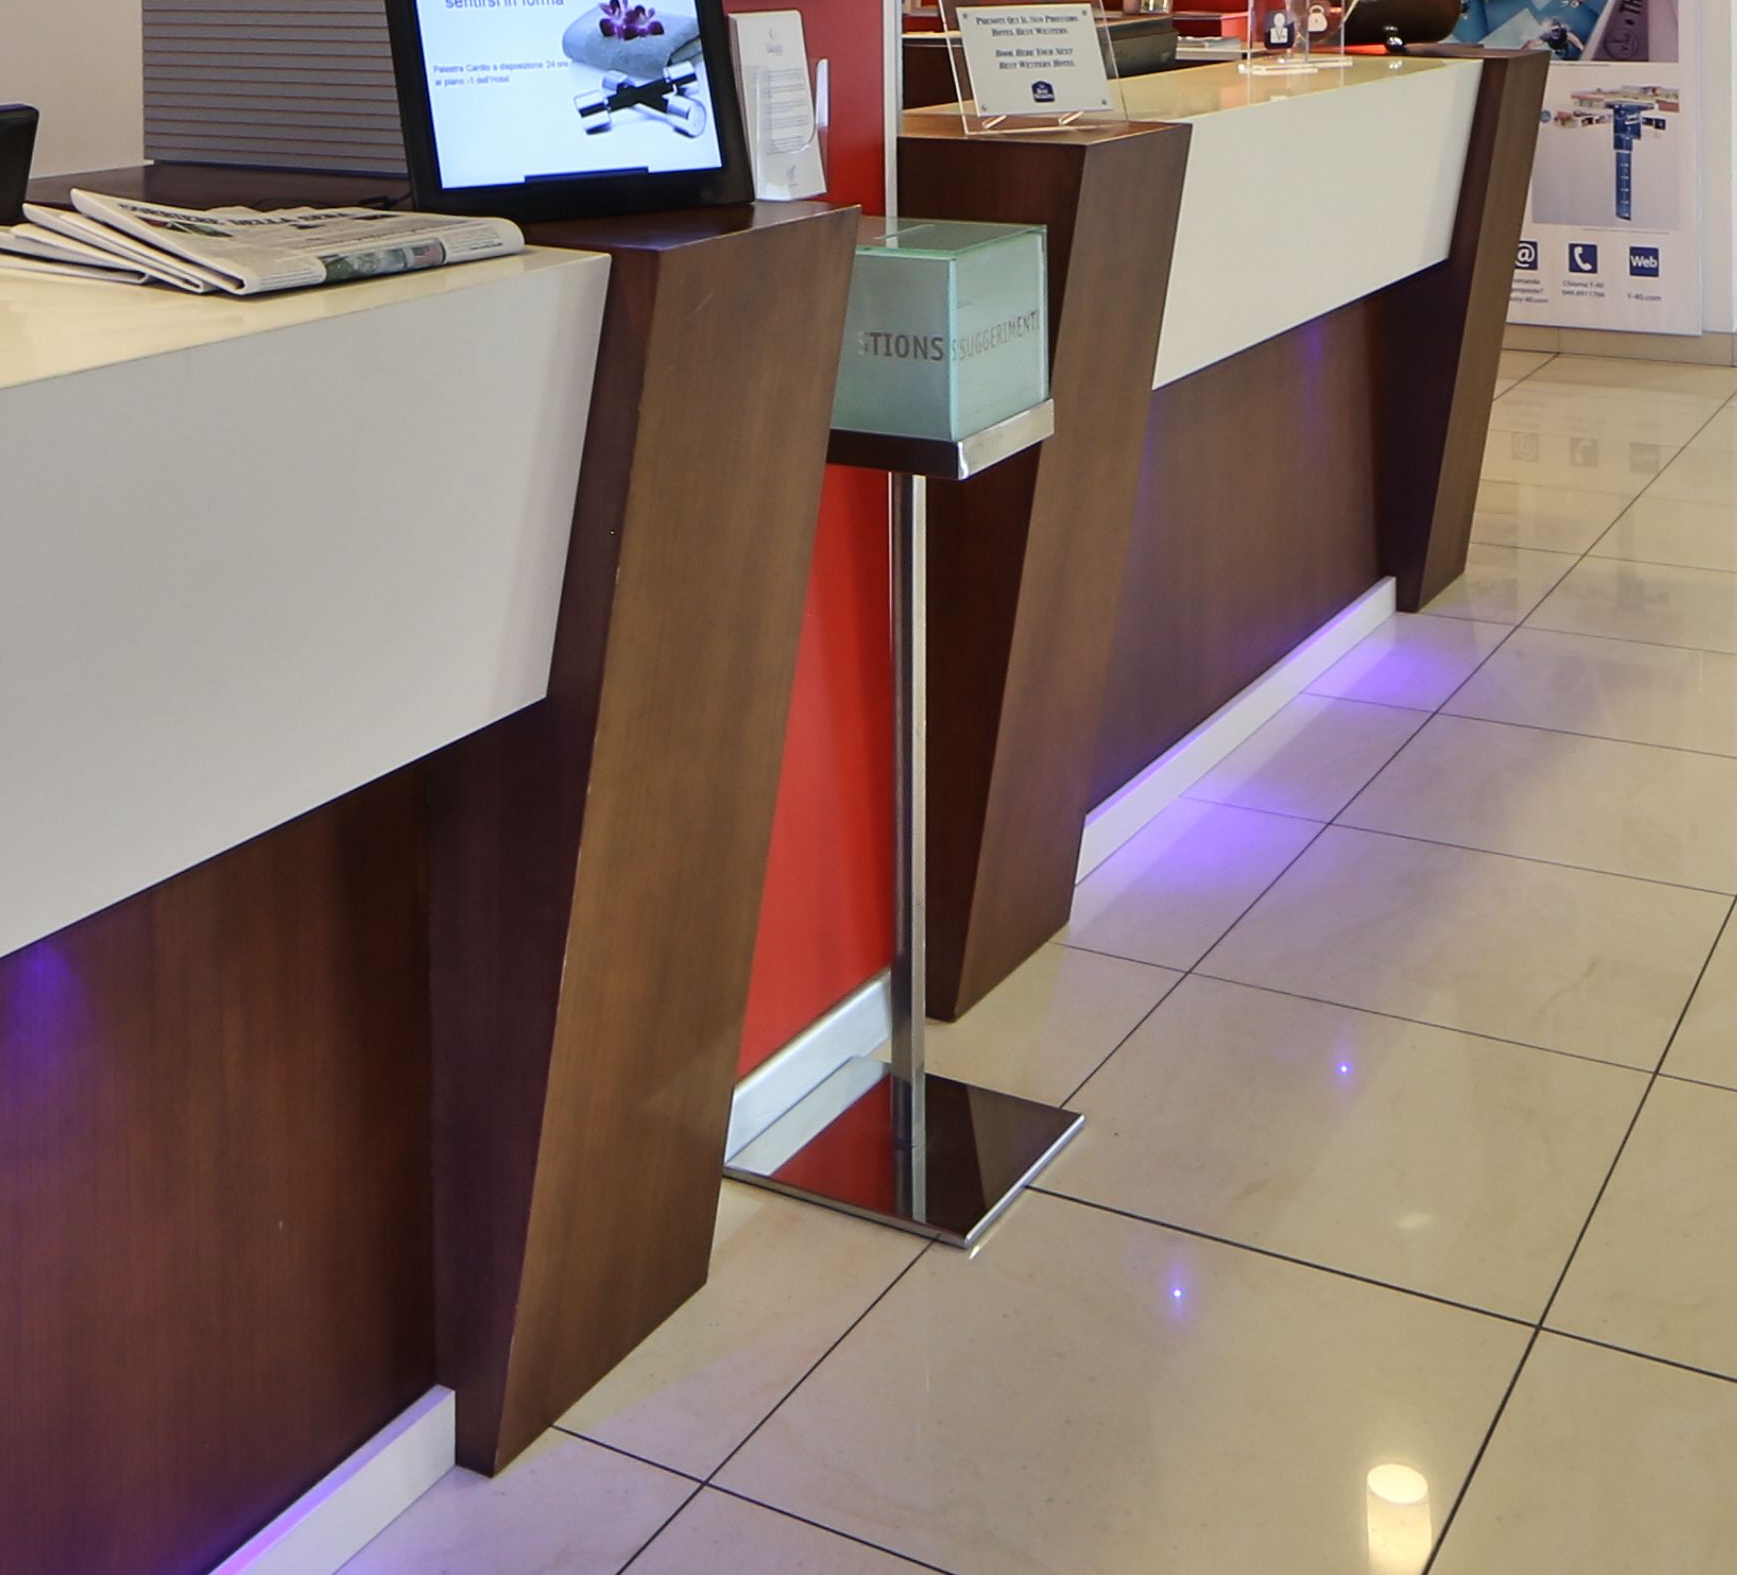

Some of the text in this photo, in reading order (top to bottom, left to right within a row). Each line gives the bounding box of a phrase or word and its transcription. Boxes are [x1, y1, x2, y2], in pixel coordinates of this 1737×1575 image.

[433, 64, 464, 74] Palestra
[466, 63, 491, 73] Cardio
[500, 61, 543, 72] disposizione
[444, 77, 464, 87] piano
[1630, 255, 1658, 268] Web
[960, 309, 1040, 361] SUGGERIMENTI
